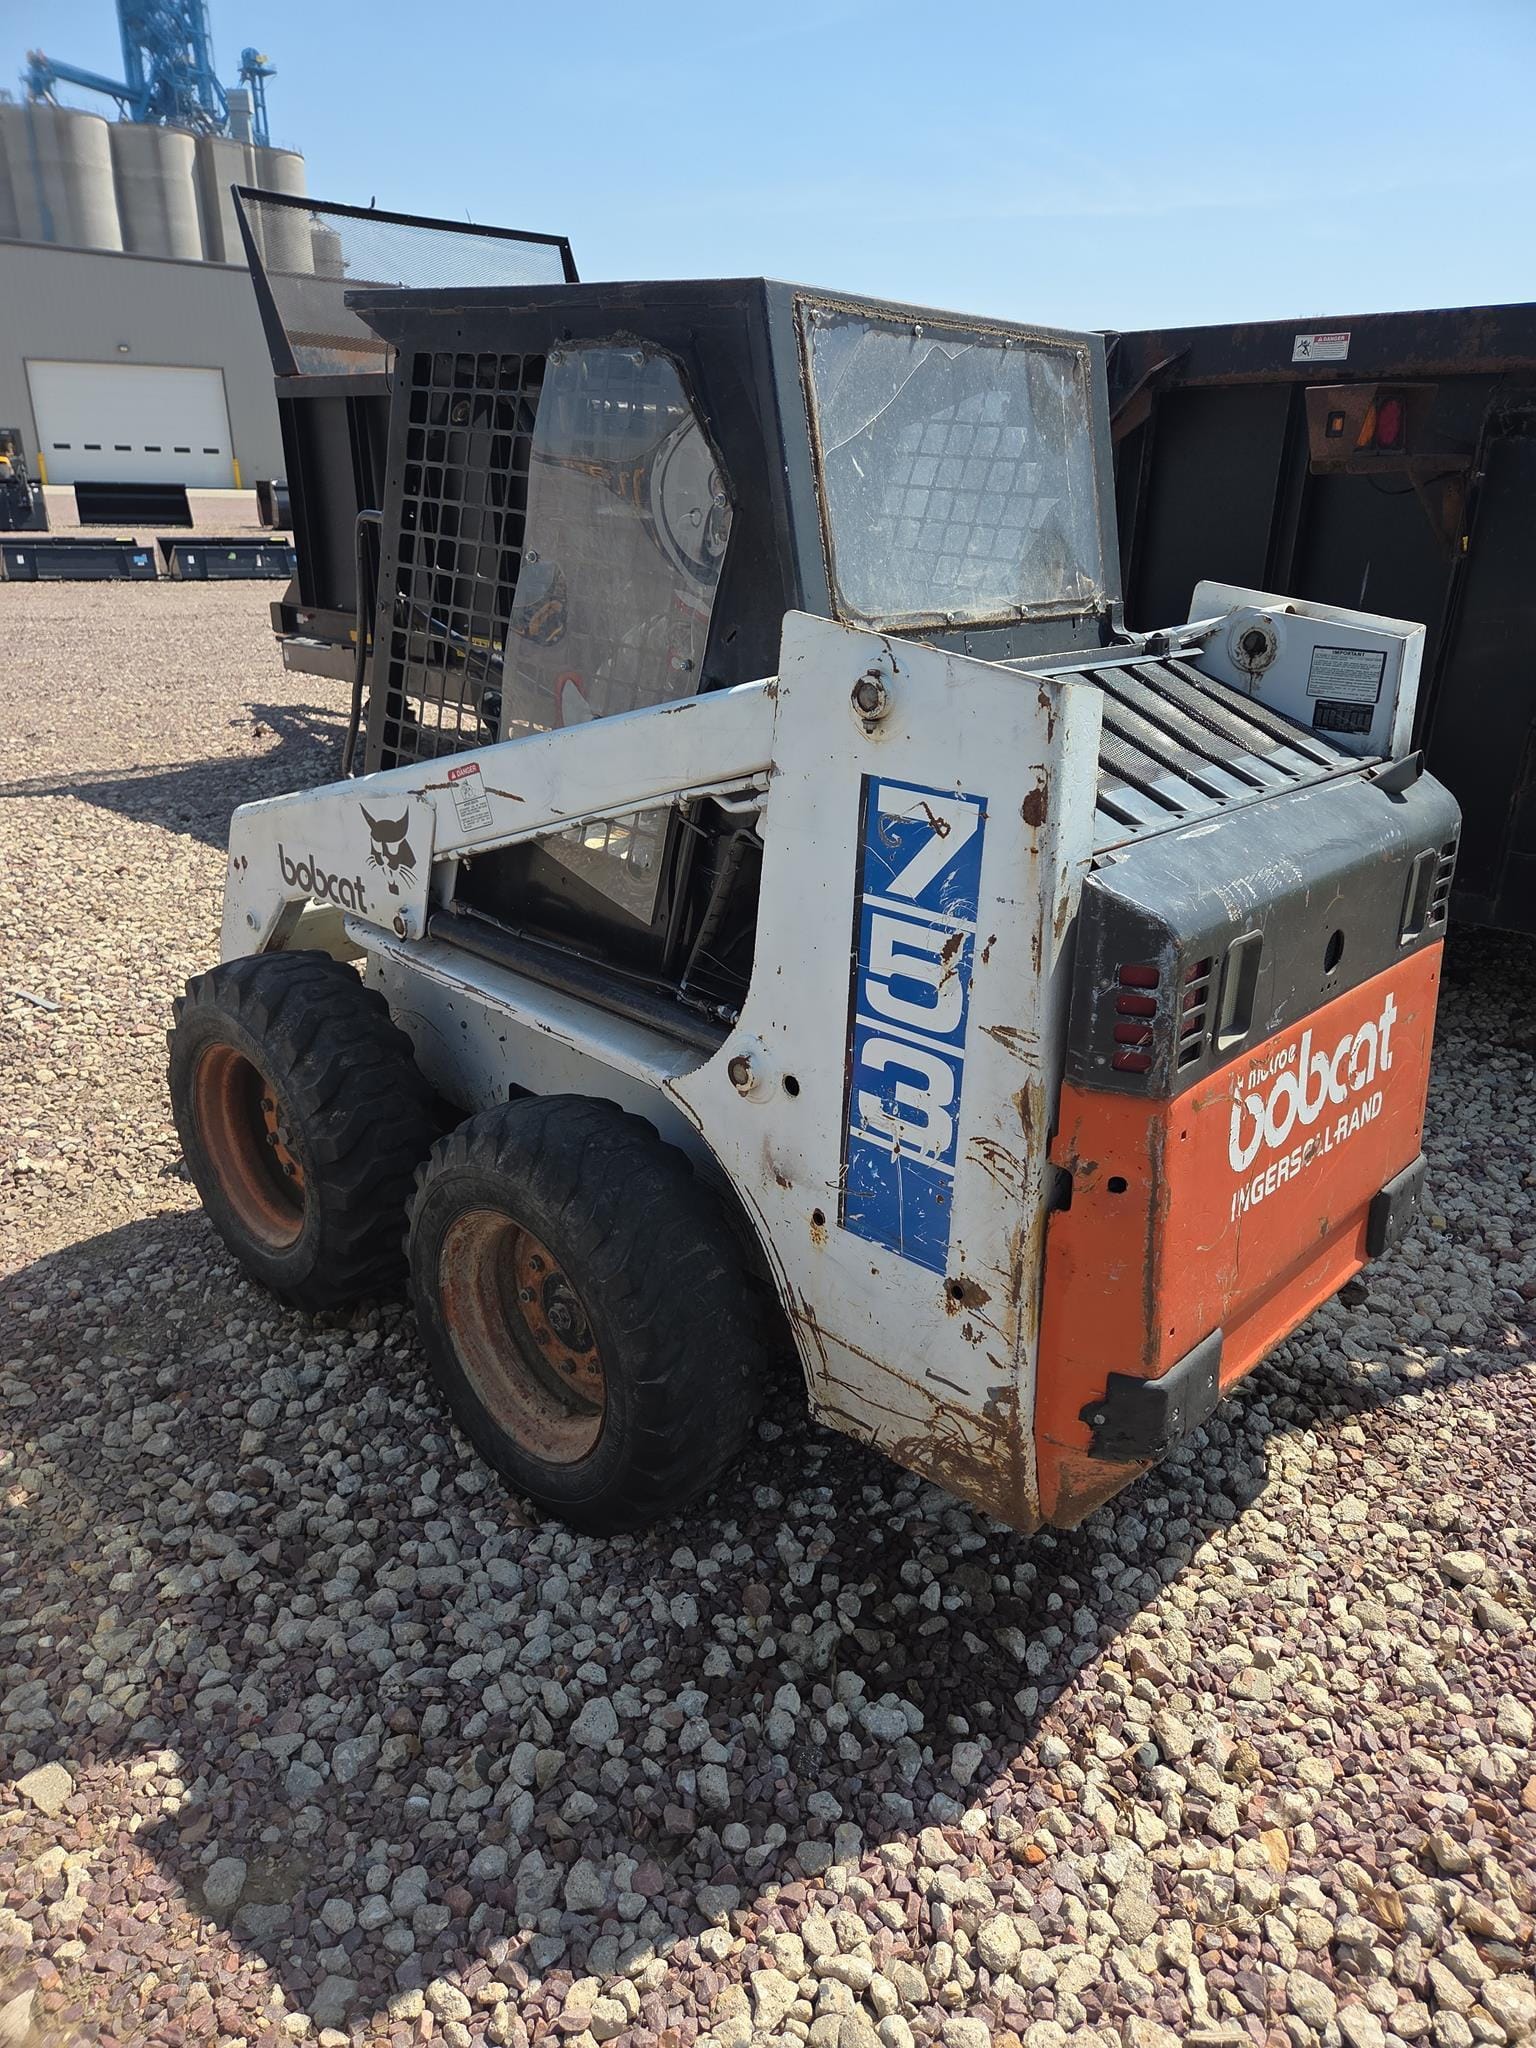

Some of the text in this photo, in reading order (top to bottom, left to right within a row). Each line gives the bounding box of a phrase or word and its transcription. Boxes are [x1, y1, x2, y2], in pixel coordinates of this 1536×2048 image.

[456, 763, 478, 777] DANGER
[278, 843, 368, 914] bobcat
[1229, 992, 1397, 1173] bobcat
